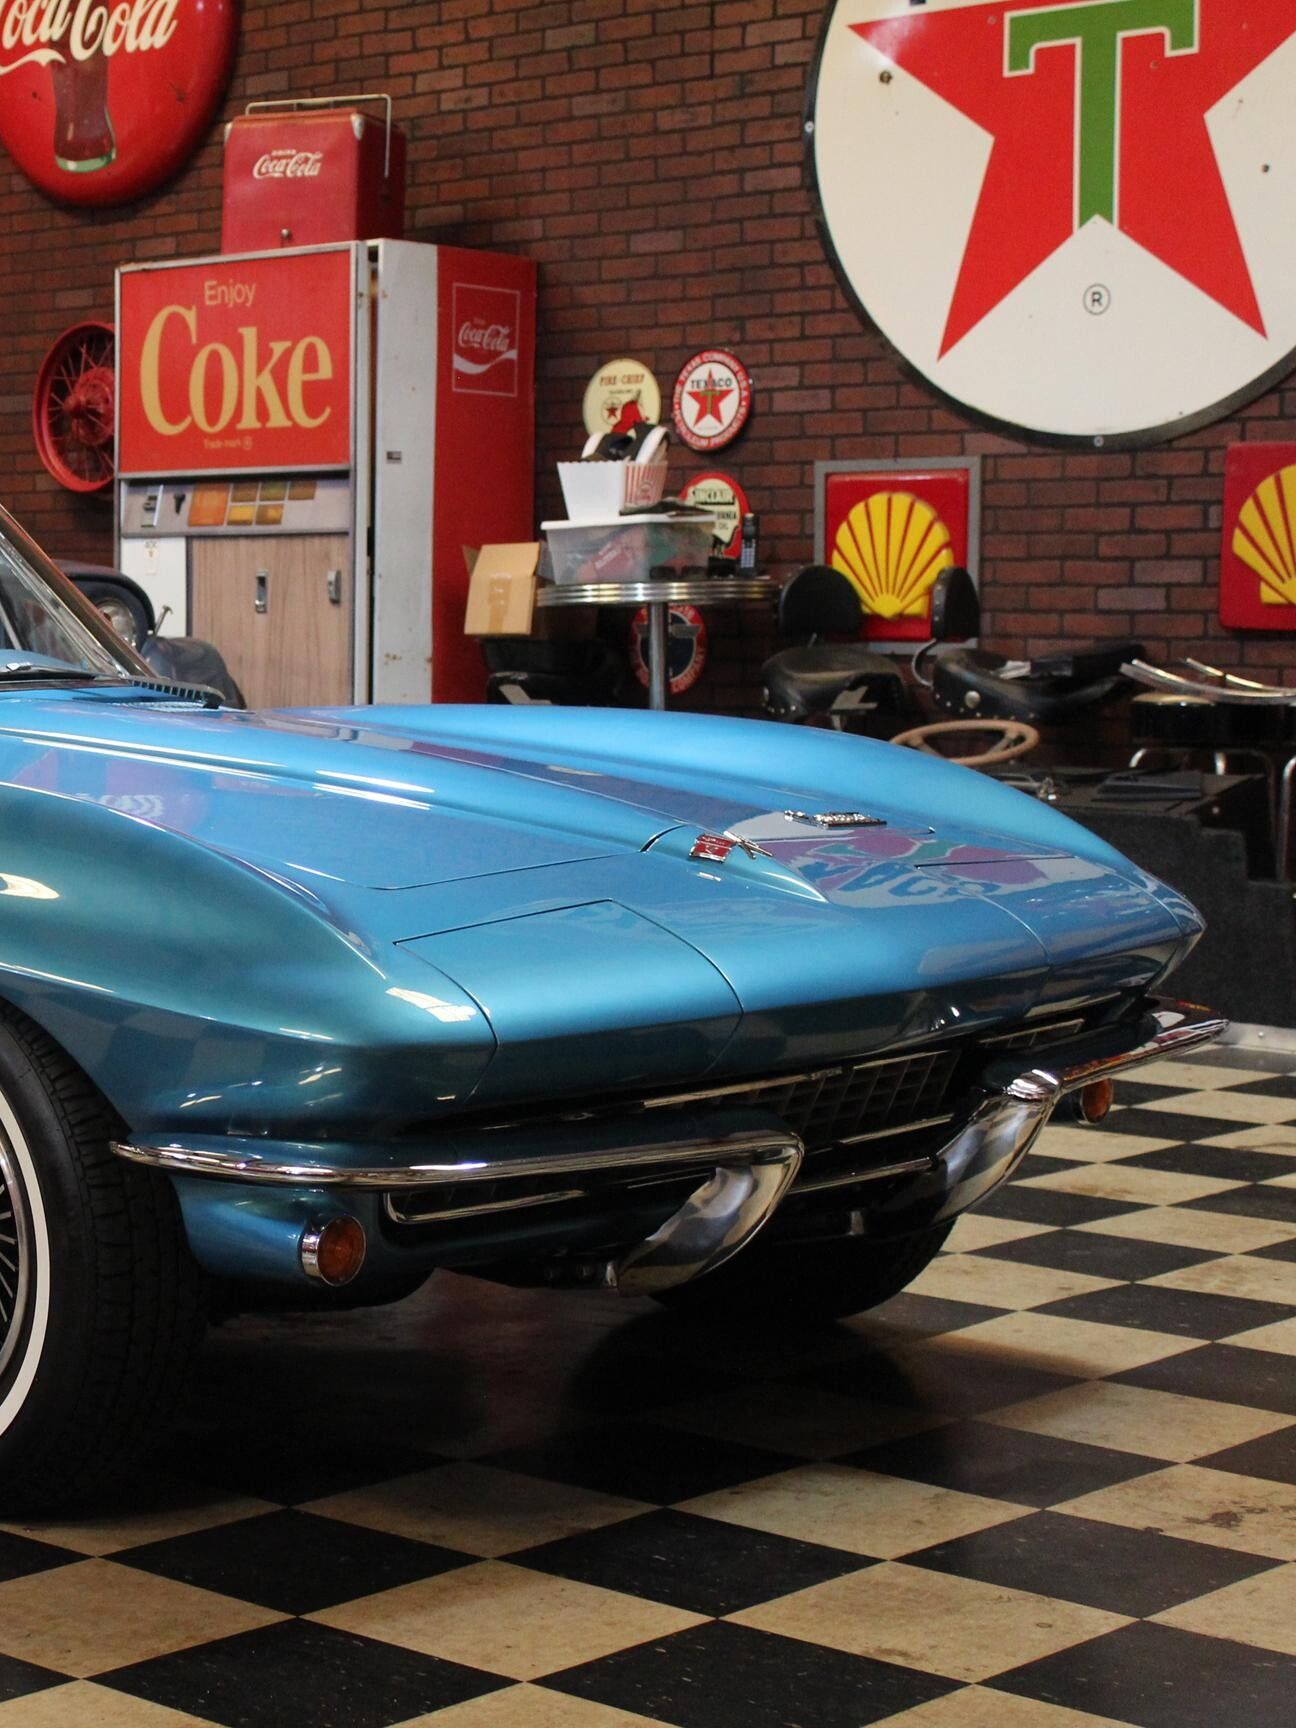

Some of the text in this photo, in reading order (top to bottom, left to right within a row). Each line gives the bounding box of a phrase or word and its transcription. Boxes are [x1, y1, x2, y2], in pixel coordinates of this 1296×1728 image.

[204, 279, 256, 308] Enjoy
[140, 304, 333, 436] Coke
[691, 378, 733, 389] TEXACO
